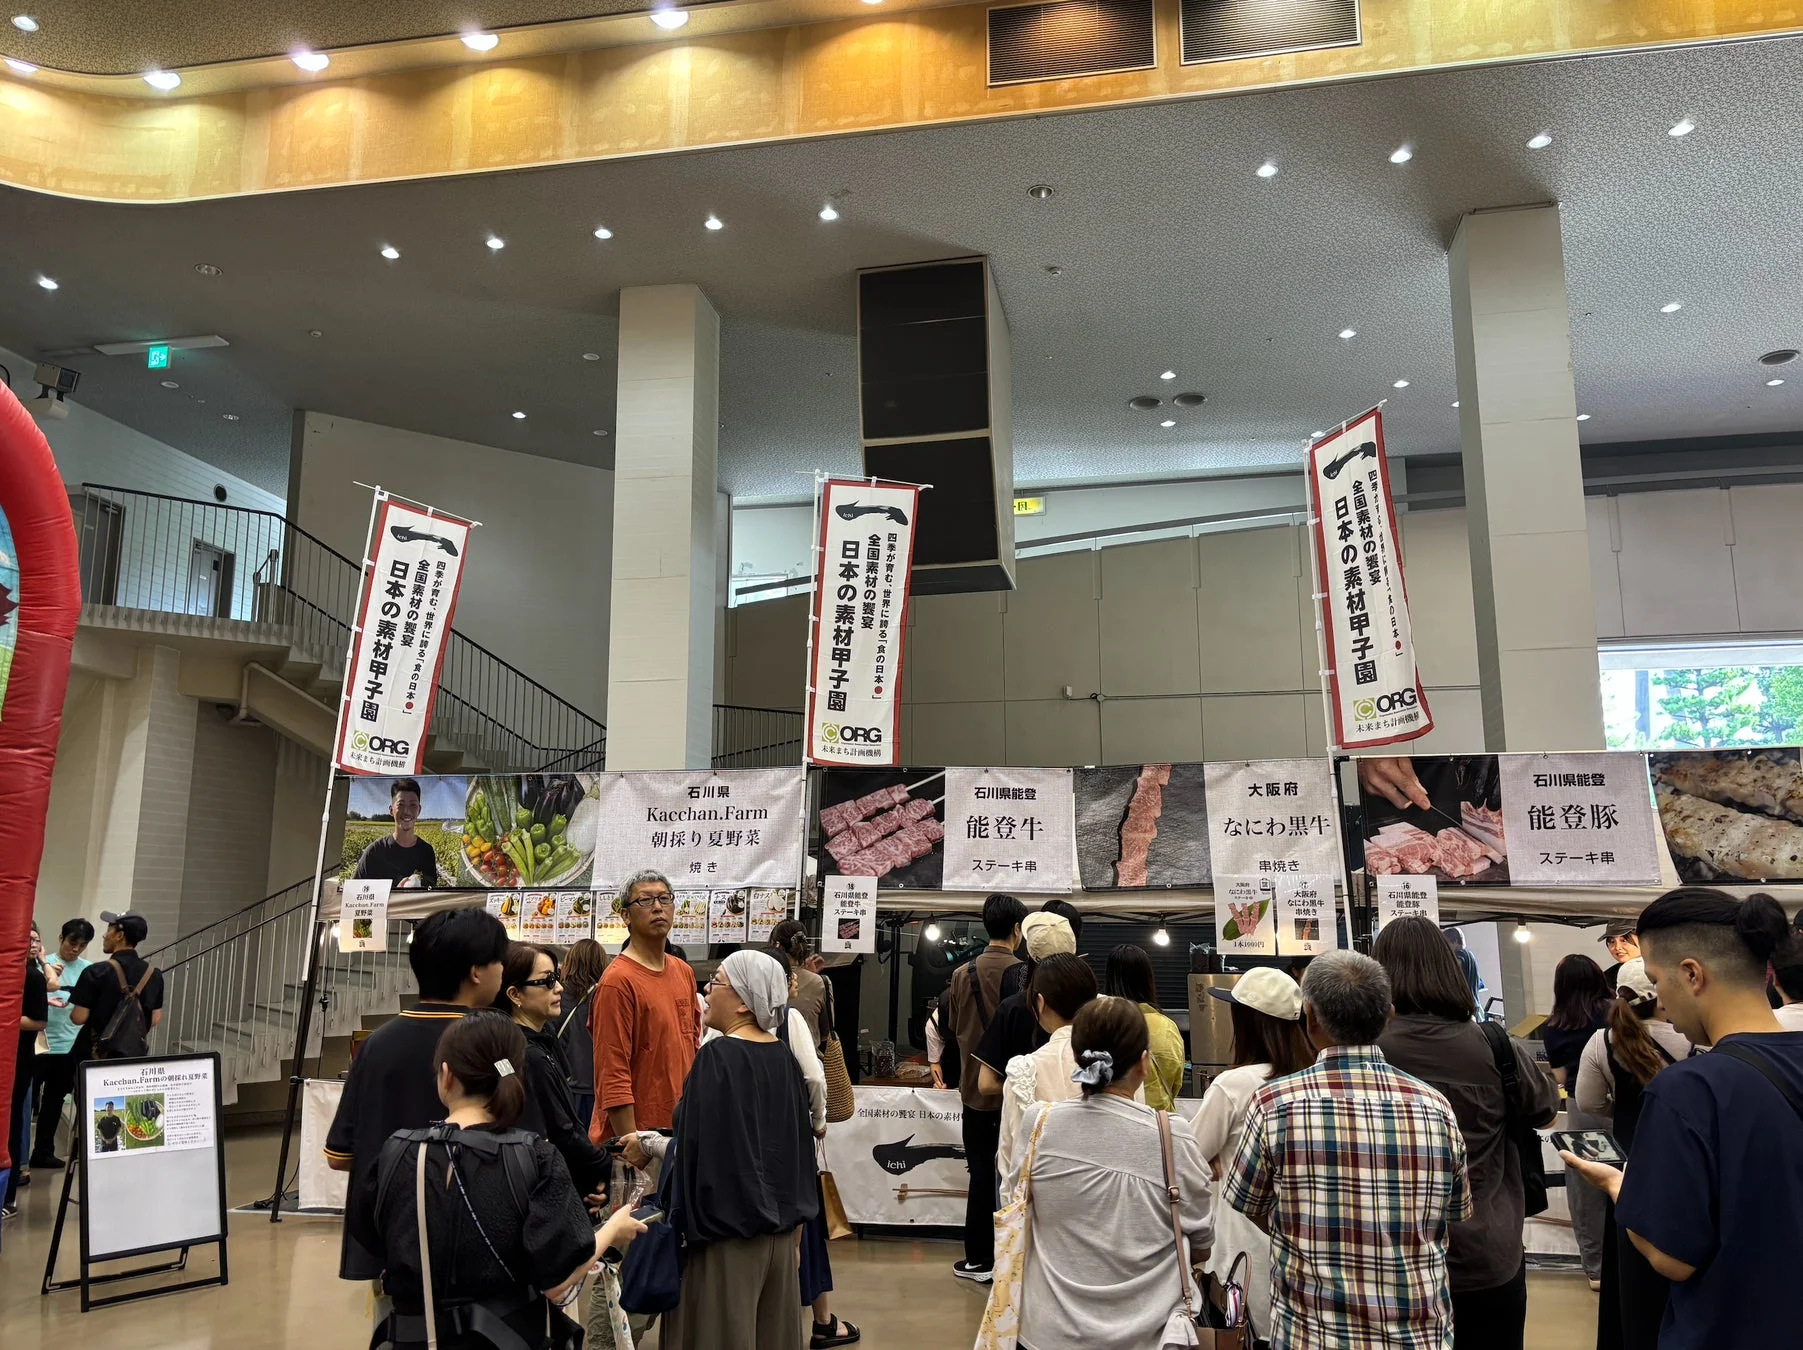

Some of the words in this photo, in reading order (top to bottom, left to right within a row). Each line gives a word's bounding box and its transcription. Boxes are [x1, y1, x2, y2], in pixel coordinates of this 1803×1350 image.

[1352, 480, 1381, 585] 全国素材の饗宴
[861, 534, 881, 629] 全国素材の饗宴
[1335, 495, 1377, 686] 日本の素材甲子園
[401, 559, 430, 648] 全国素材の饗宴
[827, 540, 860, 712] 日本の素材甲子園
[360, 560, 410, 723] 日本の素材甲子園
[822, 745, 881, 757] 未来まち計画機構
[1533, 773, 1606, 787] 石川県能登
[688, 785, 730, 799] 石川県
[974, 787, 1036, 800] 石川県能登
[1248, 782, 1298, 797] 大阪府
[646, 806, 768, 821] Kacchan.Farm
[1527, 804, 1619, 830] 能登豚
[966, 815, 1044, 840] 能登牛
[1223, 815, 1331, 836] なにわ黒牛
[651, 829, 761, 848] 朝採り夏野菜
[1540, 851, 1615, 865] ステーキ串
[689, 861, 718, 874] 焼き
[972, 859, 1037, 872] ステーキ串
[1259, 860, 1299, 872] 串焼き
[834, 891, 868, 899] 石川県能登
[1294, 890, 1317, 898] 大阪府
[1388, 891, 1428, 899] 石川県能登
[840, 900, 861, 908] 能登牛
[1287, 899, 1325, 907] なにわ黒牛
[1396, 900, 1421, 908] 能登豚
[355, 909, 373, 917] 夏野菜
[834, 909, 867, 917] ステーキ串
[141, 1067, 165, 1075] 石川県
[857, 1108, 916, 1119] 全国素材の饗宴
[919, 1111, 964, 1122] 日本の素材
[887, 1160, 907, 1170] ichi
